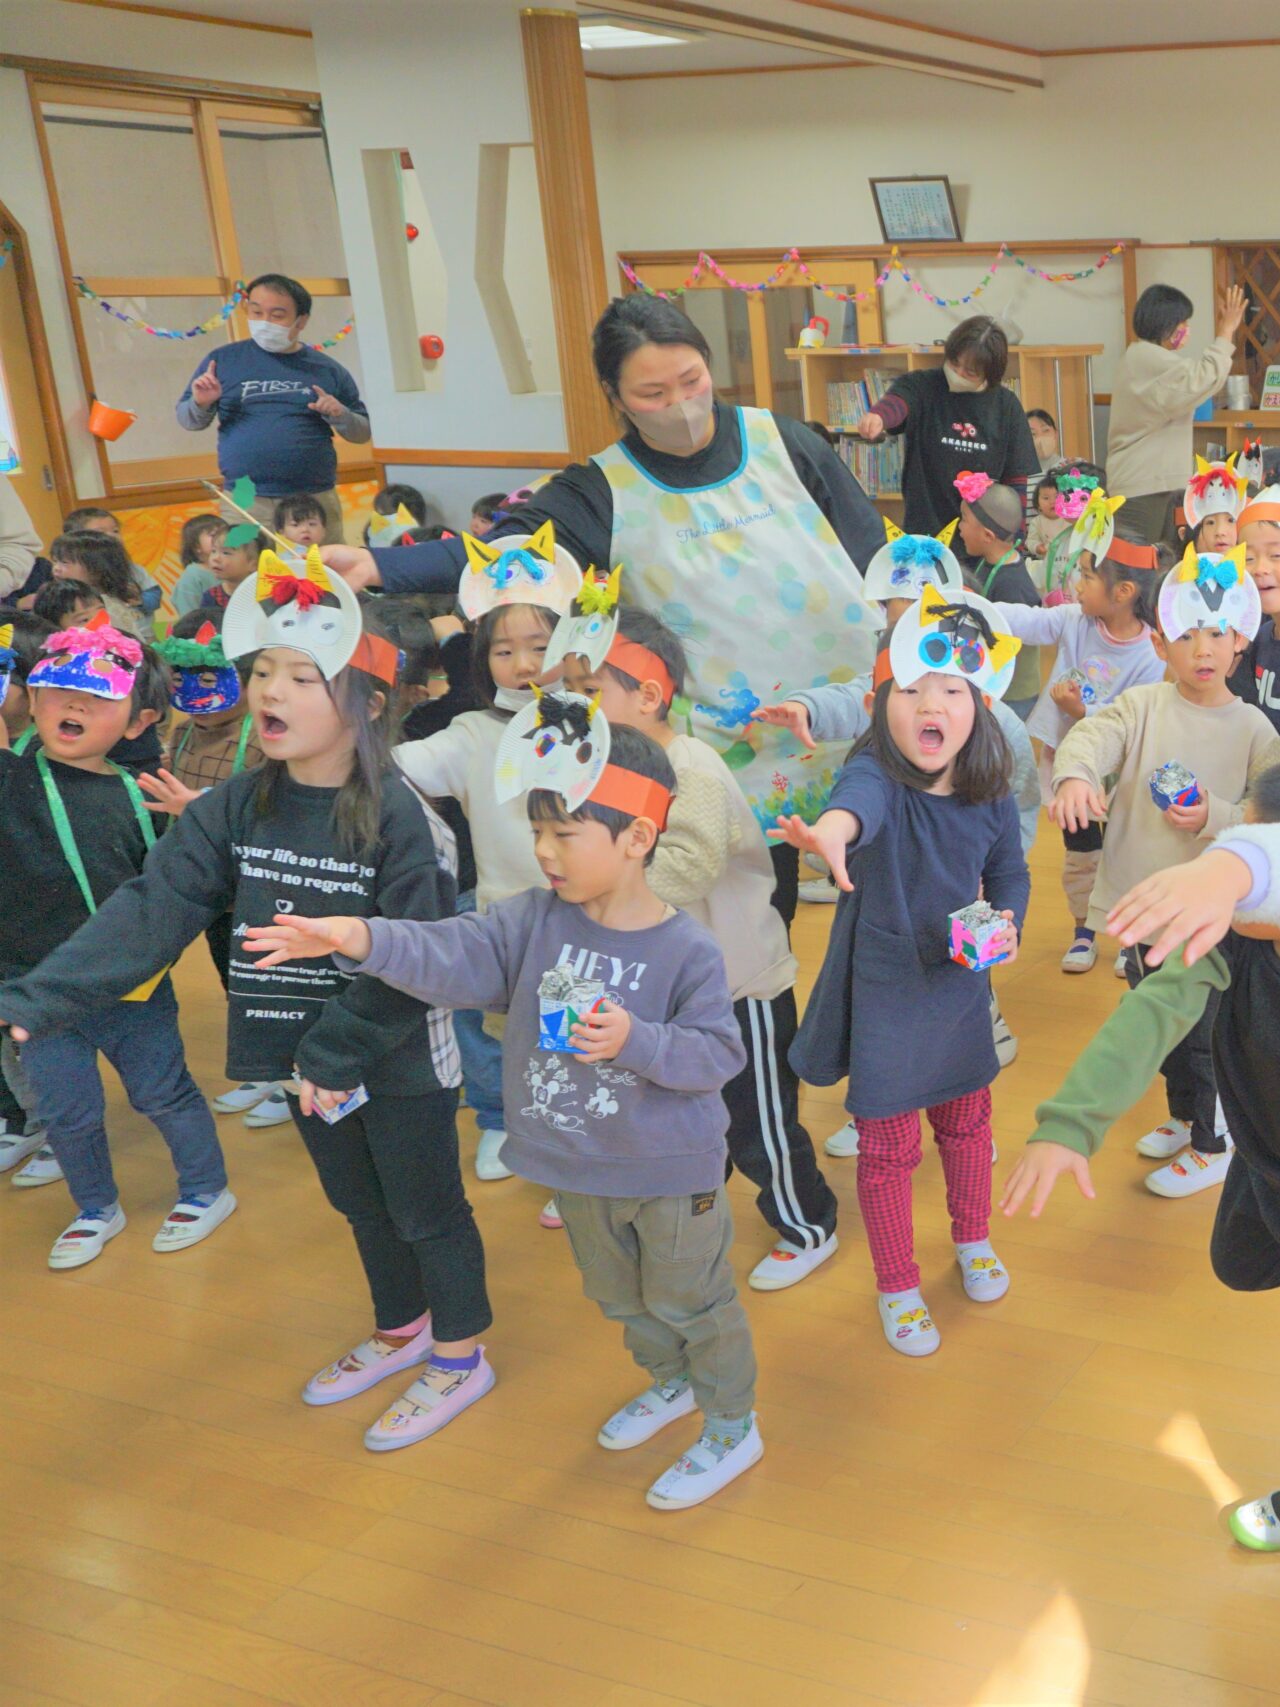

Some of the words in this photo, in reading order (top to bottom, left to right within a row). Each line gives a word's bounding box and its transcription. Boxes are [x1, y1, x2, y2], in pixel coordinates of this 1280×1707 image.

[241, 380, 302, 398] FIRST
[676, 528, 699, 544] The
[703, 518, 732, 536] Little
[735, 503, 777, 528] Mermaid
[272, 848, 298, 864] life
[299, 856, 318, 868] so
[319, 857, 358, 873] that
[358, 865, 376, 878] yo
[281, 873, 302, 886] no
[557, 943, 648, 991] HEY!
[246, 1009, 306, 1020] PRIMACY
